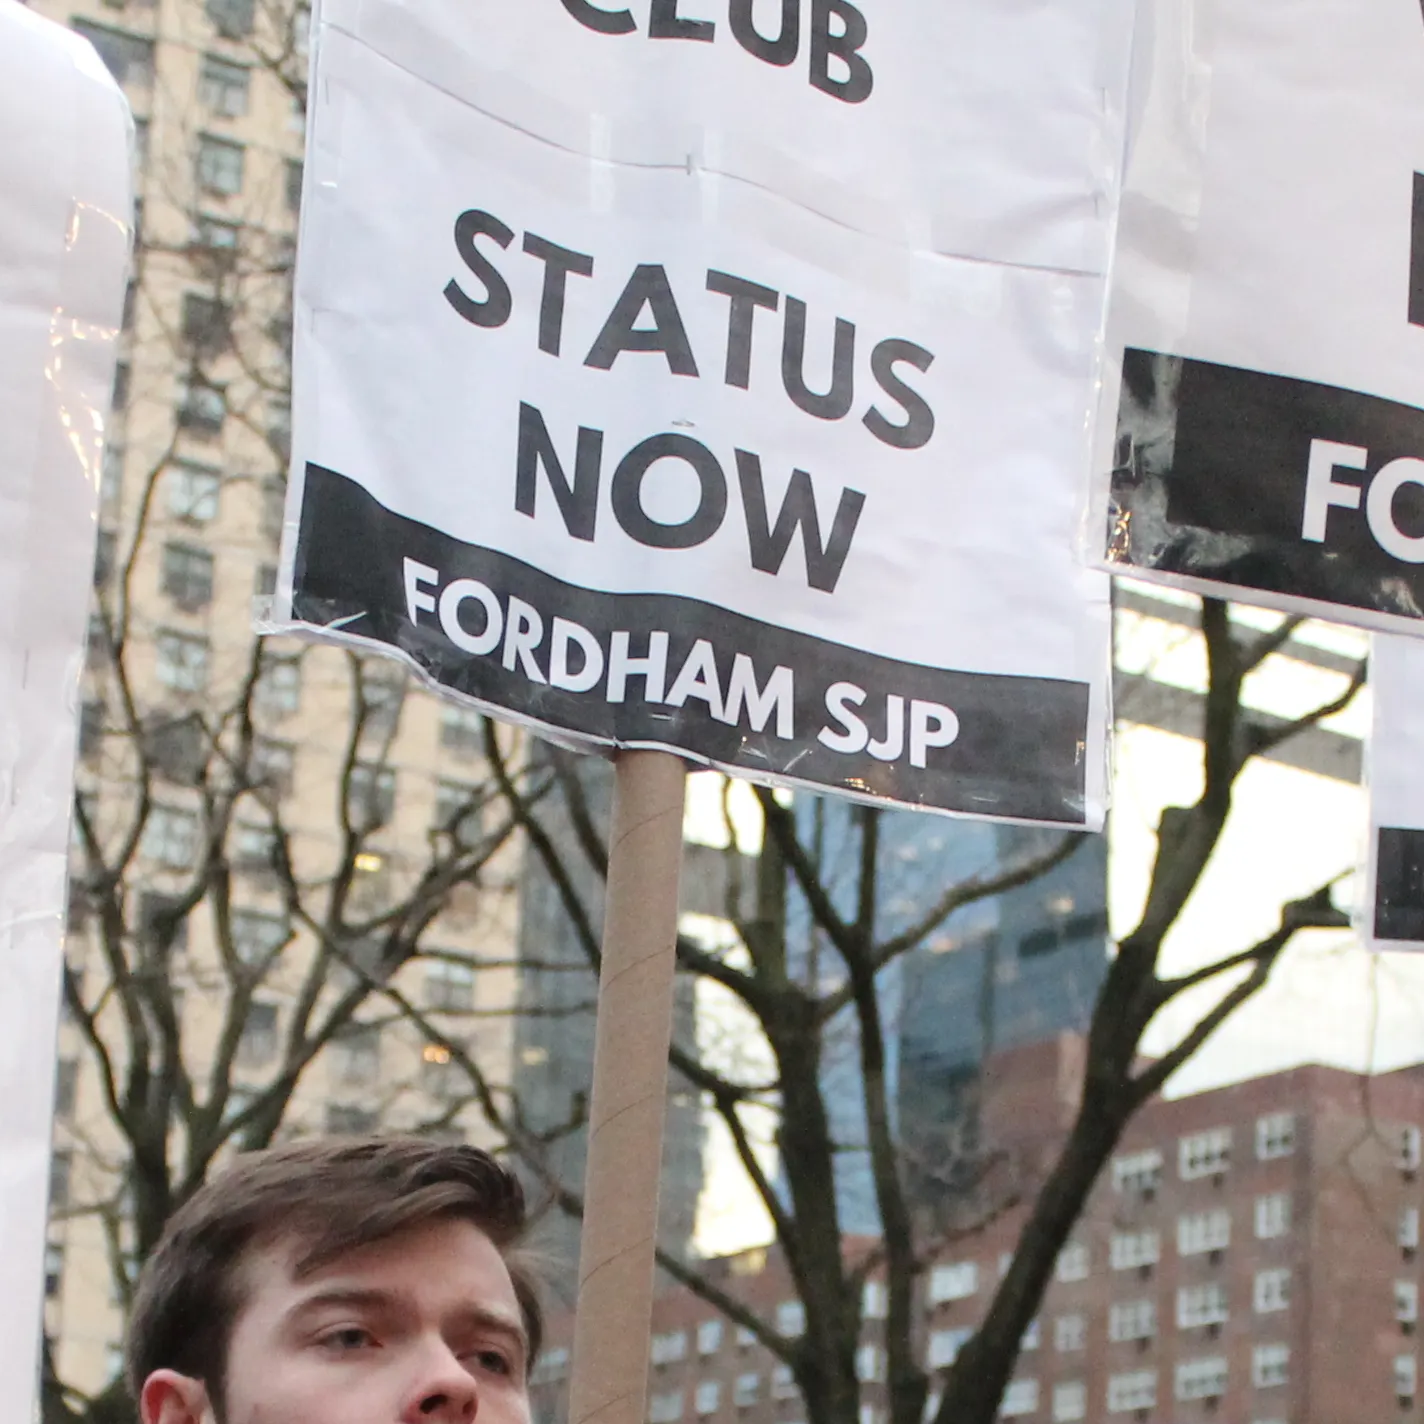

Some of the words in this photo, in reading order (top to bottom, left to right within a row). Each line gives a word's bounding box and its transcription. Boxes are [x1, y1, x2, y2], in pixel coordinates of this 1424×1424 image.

[442, 208, 936, 449] STATUS
[514, 400, 867, 594] NOW
[402, 556, 794, 741] FORDHAM
[817, 681, 960, 768] SJP
